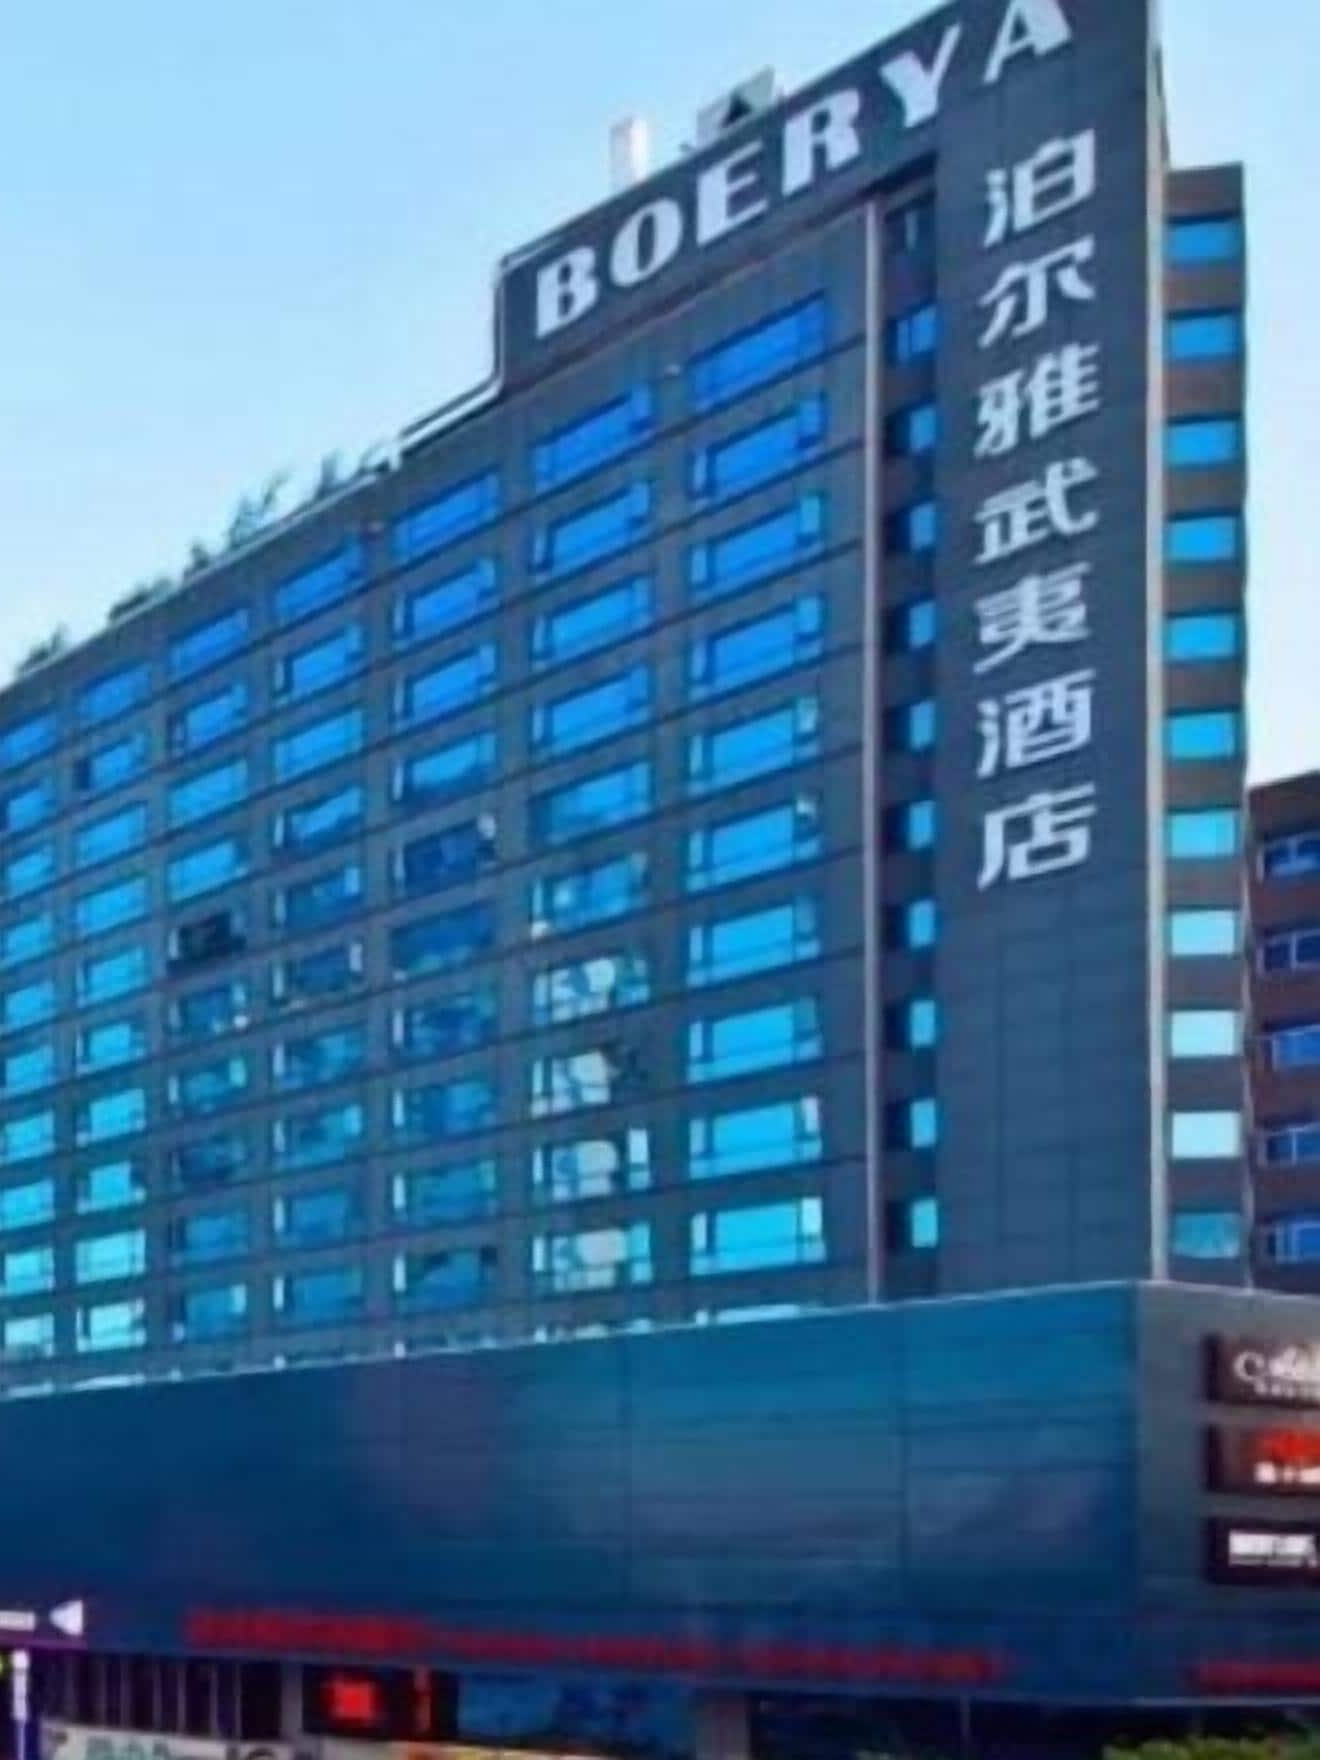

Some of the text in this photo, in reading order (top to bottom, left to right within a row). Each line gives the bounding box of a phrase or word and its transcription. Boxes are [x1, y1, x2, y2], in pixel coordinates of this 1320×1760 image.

[535, 0, 1072, 339] BOERYA
[973, 128, 1098, 888] 泊尔雅武夷酒店
